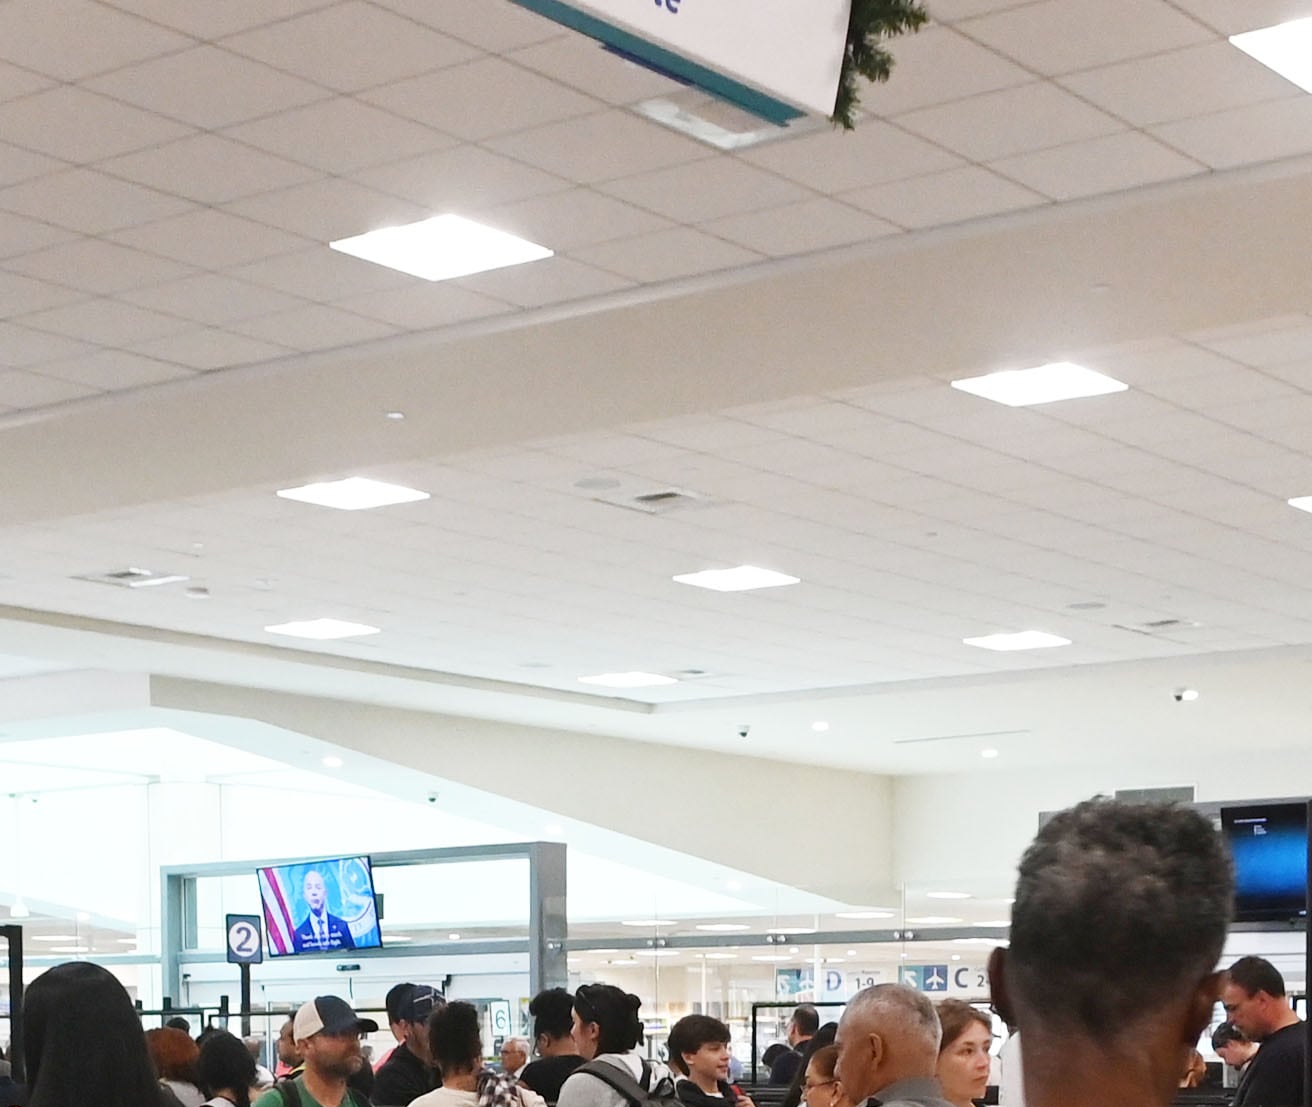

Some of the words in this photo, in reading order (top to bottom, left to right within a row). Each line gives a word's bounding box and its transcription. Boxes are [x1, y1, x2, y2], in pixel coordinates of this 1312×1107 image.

[236, 926, 253, 953] 2
[826, 970, 842, 992] D
[954, 967, 969, 989] C
[495, 1009, 506, 1030] 6
